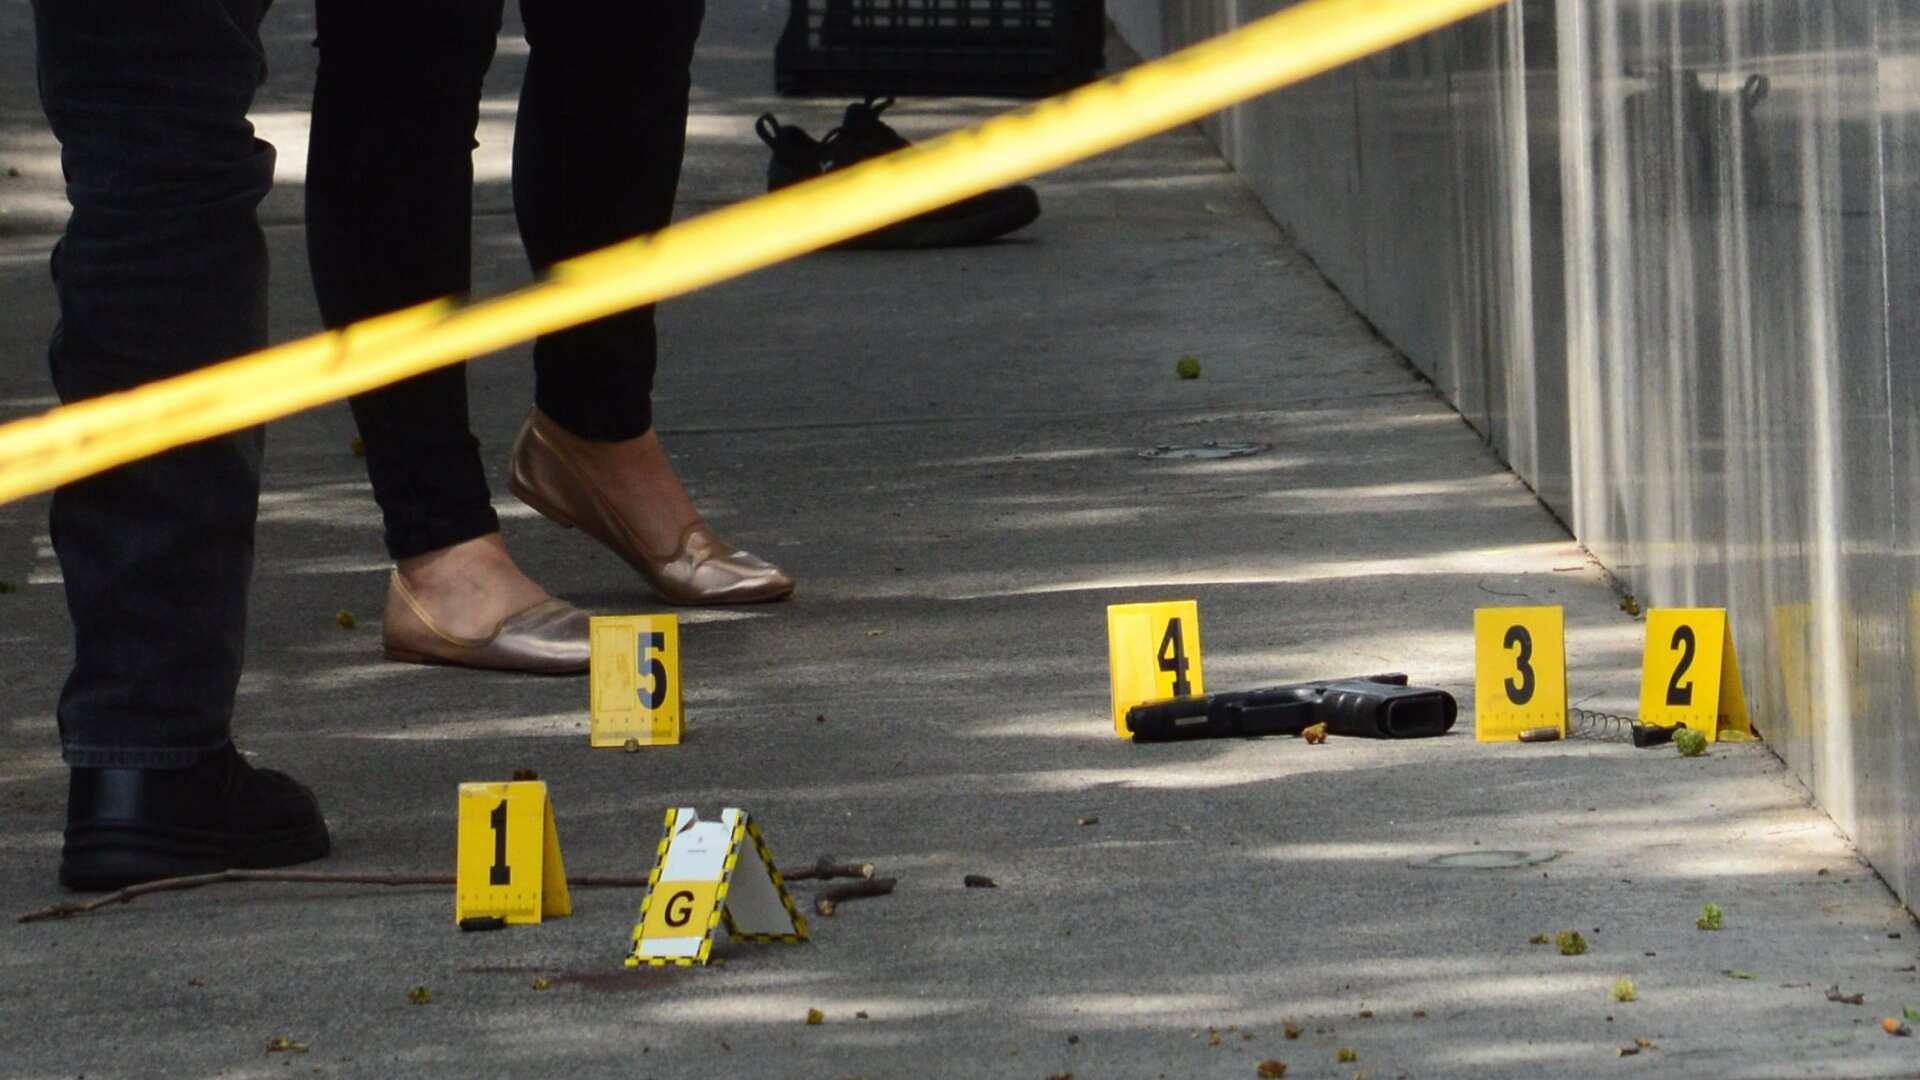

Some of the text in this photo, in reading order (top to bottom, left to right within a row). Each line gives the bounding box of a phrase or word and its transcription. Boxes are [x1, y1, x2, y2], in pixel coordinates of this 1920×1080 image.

[638, 632, 667, 710] 5
[1157, 617, 1191, 697] 4
[1504, 625, 1535, 705] 3
[1665, 625, 1695, 706] 2
[489, 800, 511, 885] 1
[664, 890, 695, 927] G
